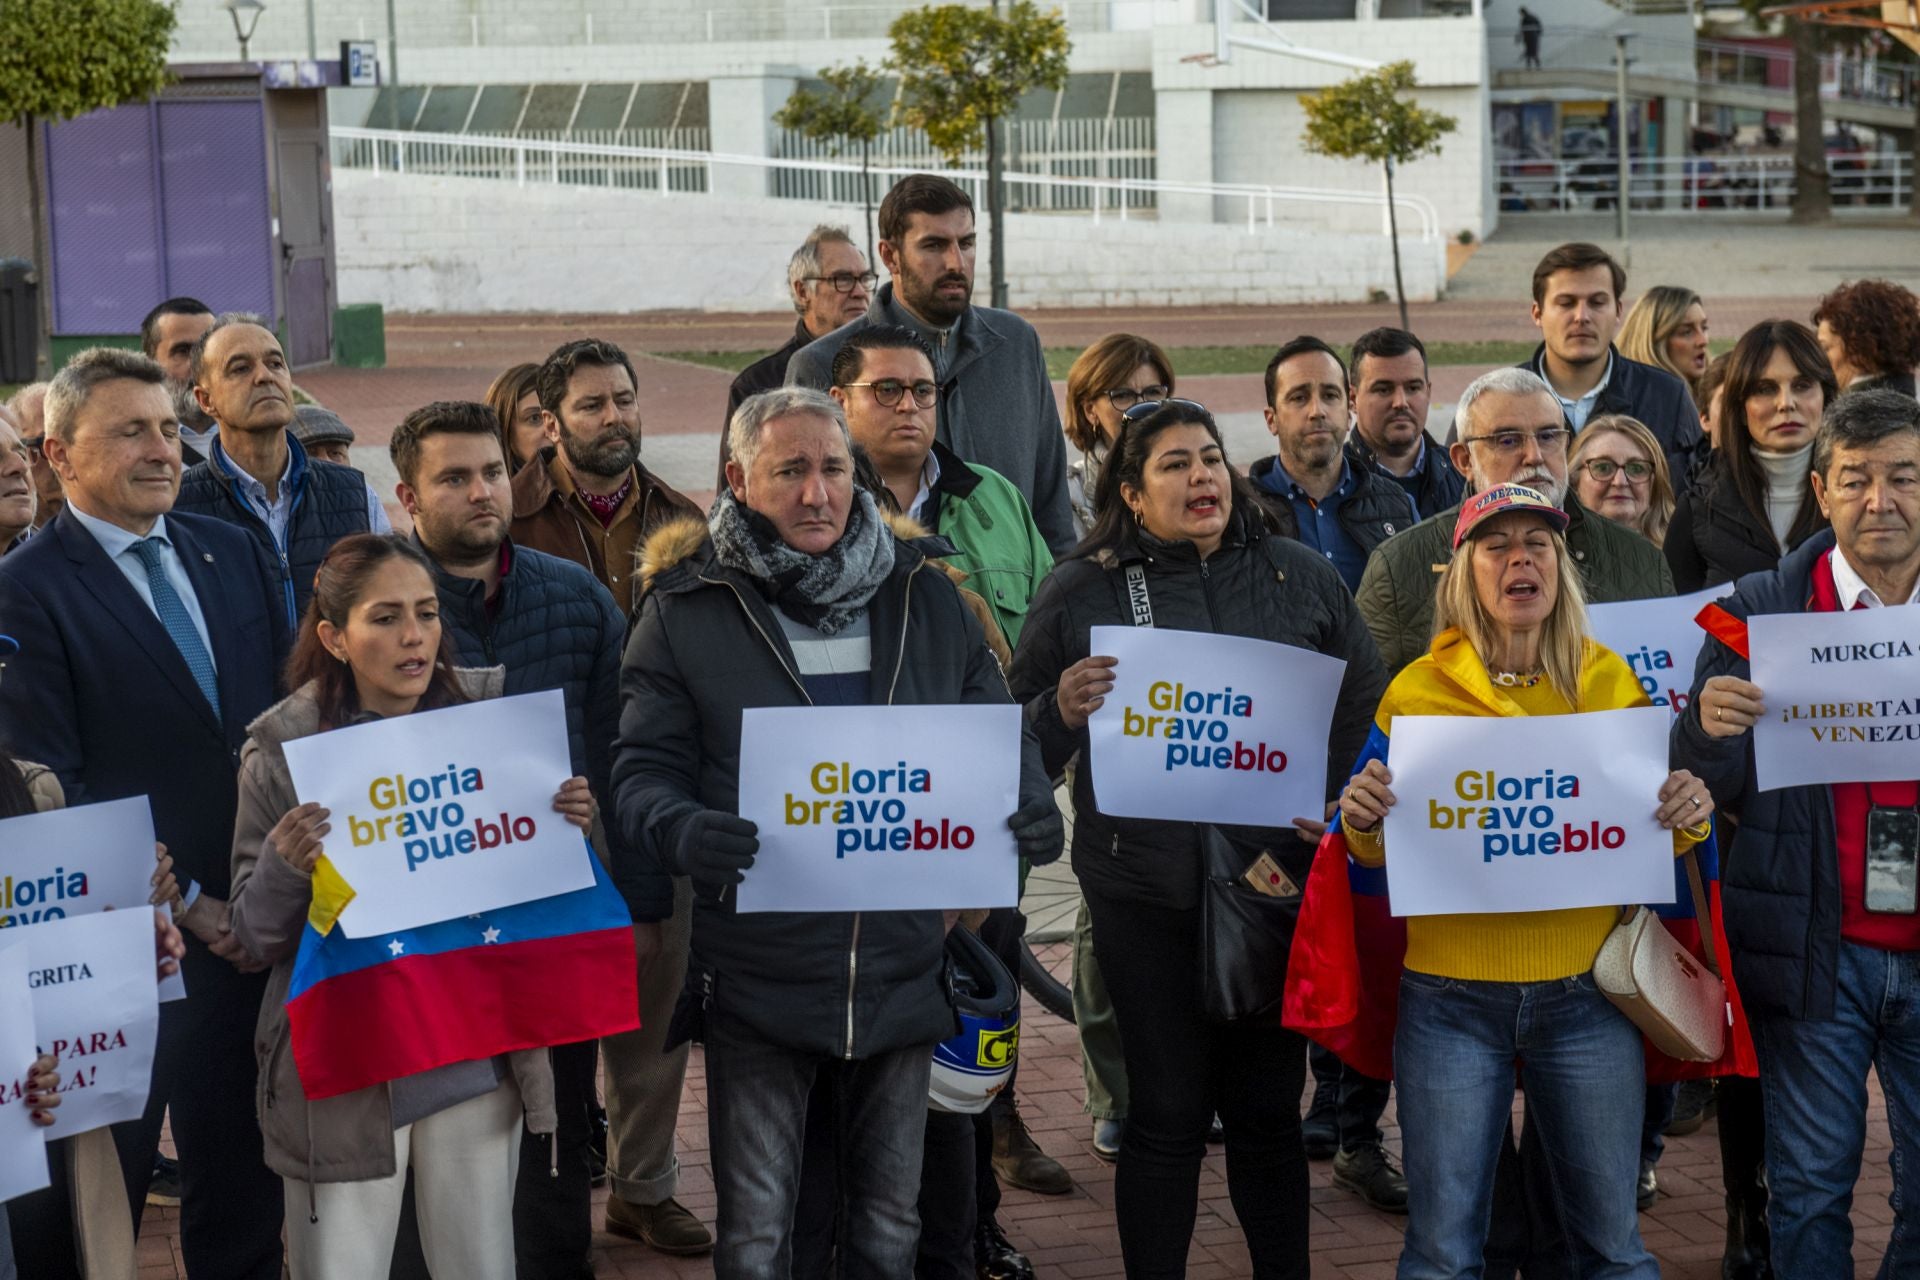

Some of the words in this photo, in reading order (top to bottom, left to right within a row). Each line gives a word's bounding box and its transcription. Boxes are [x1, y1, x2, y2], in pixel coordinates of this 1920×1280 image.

[1626, 645, 1674, 674] ria
[1811, 640, 1914, 664] MURCIA
[1148, 681, 1253, 718] Gloria
[1123, 706, 1229, 744] bravo
[1810, 723, 1920, 743] VENEZU
[1165, 740, 1288, 774] pueblo
[369, 763, 484, 811] Gloria
[810, 760, 931, 795] Gloria
[1454, 768, 1580, 801] Gloria
[347, 801, 465, 848] bravo
[784, 793, 906, 826] bravo
[1428, 799, 1554, 830] bravo
[403, 812, 537, 872] pueblo
[836, 818, 975, 859] pueblo
[1483, 820, 1626, 863] pueblo
[0, 867, 88, 909] loria
[28, 962, 94, 989] GRITA
[52, 1028, 128, 1060] PARA
